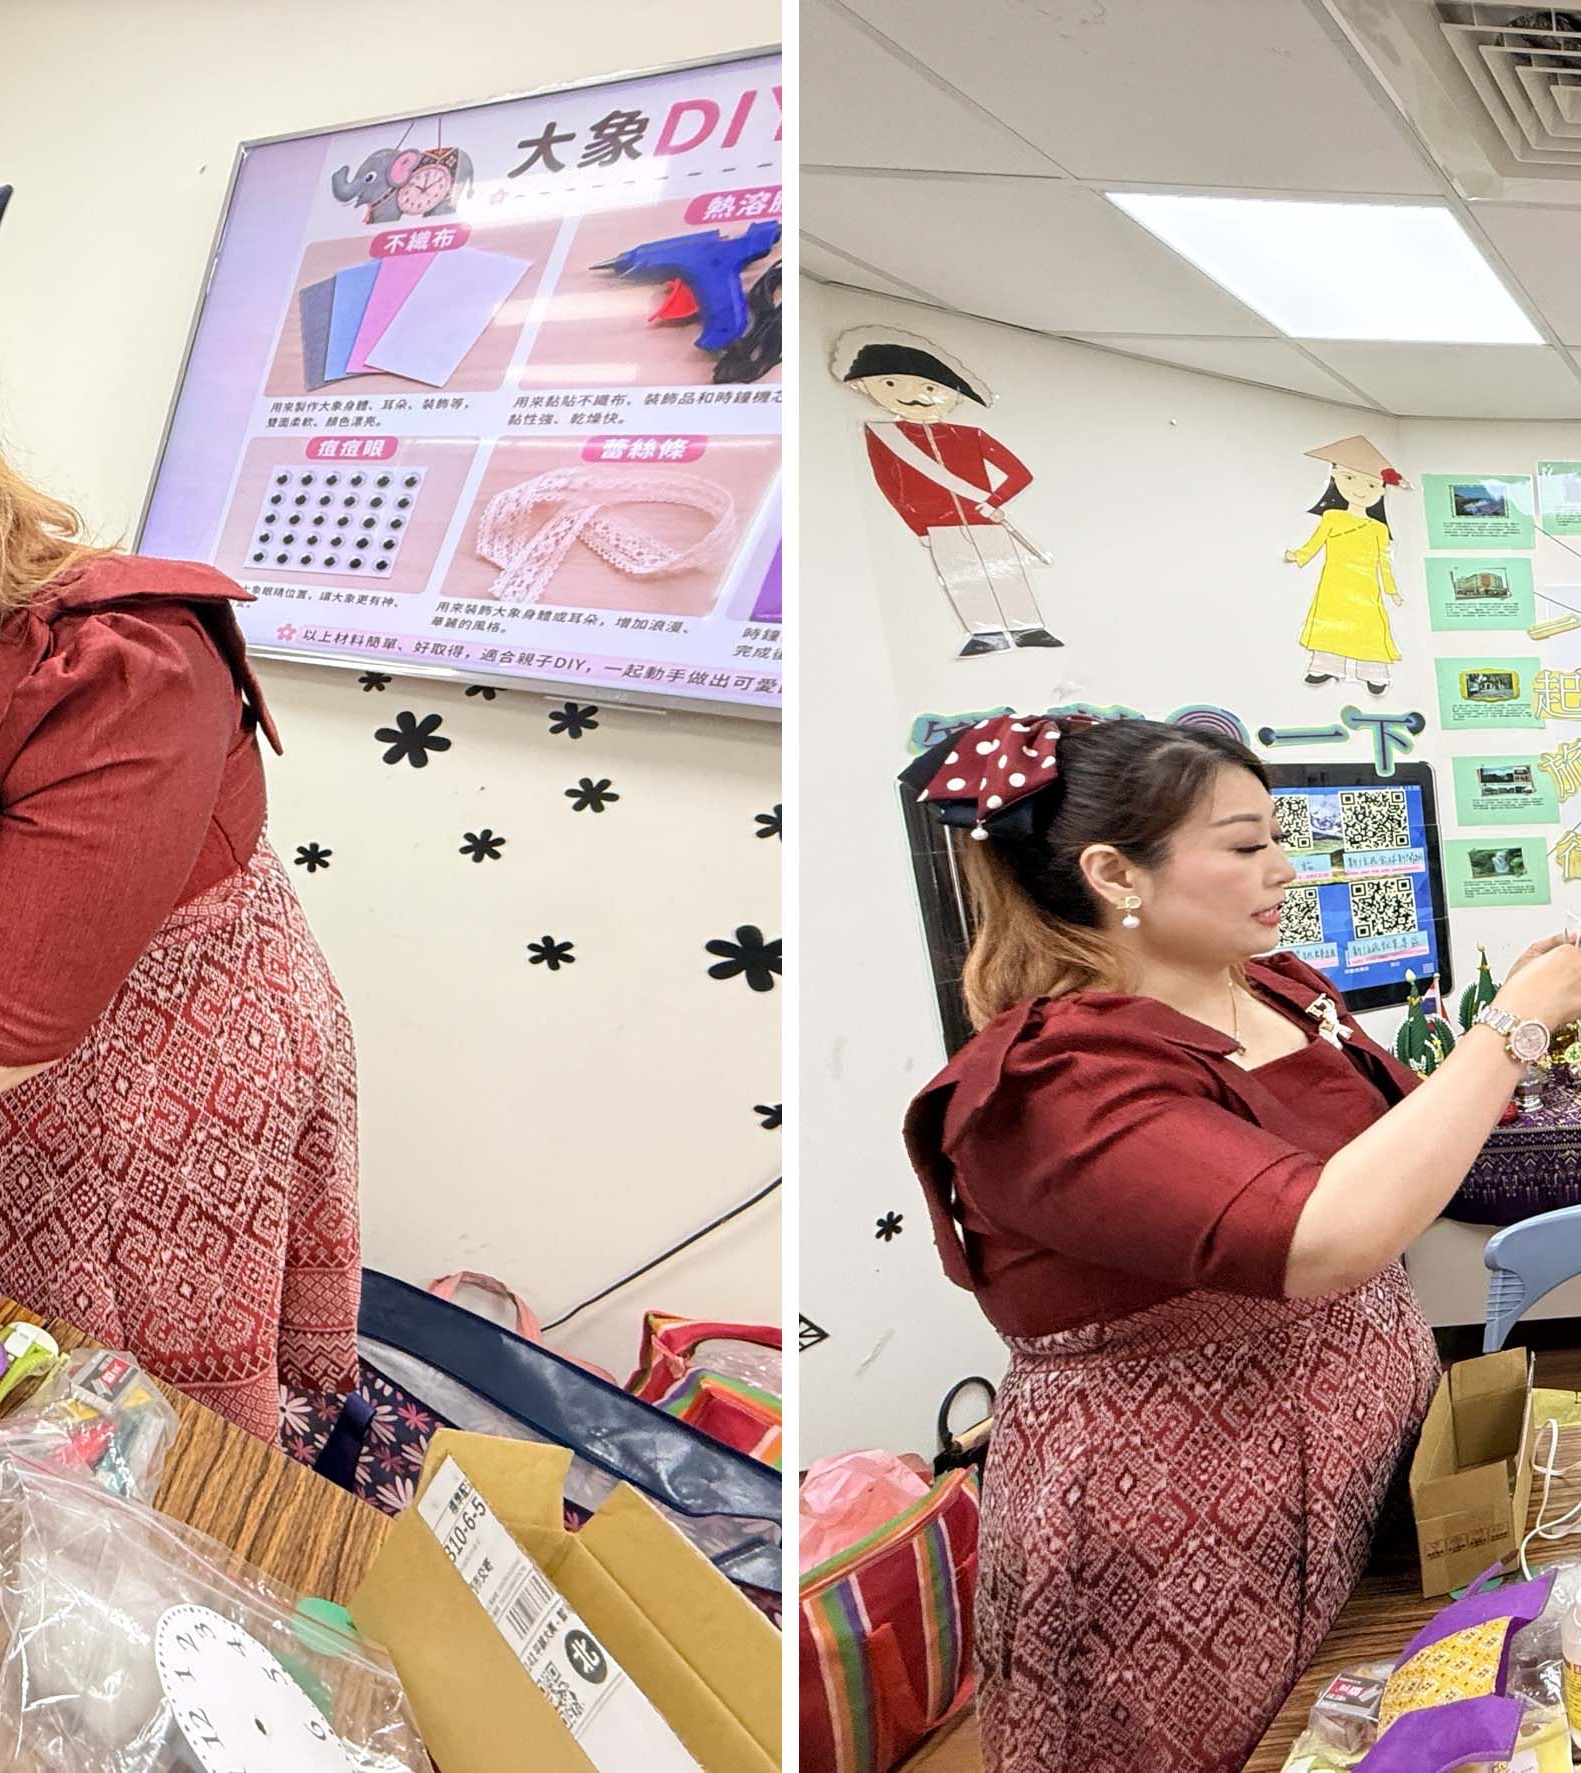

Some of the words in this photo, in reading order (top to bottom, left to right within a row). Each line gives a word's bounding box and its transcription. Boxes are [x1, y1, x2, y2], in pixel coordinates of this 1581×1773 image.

[383, 228, 457, 253] 不織布
[317, 439, 386, 457] 痘痘眼
[600, 437, 689, 460] 蕾絲條
[302, 628, 782, 695] 以上材料簡單、好取得，適合親子DIY，一起動手做出可愛
[175, 1632, 200, 1653] 2
[194, 1622, 217, 1640] 3
[571, 1638, 600, 1674] 北
[188, 1707, 226, 1751] 12
